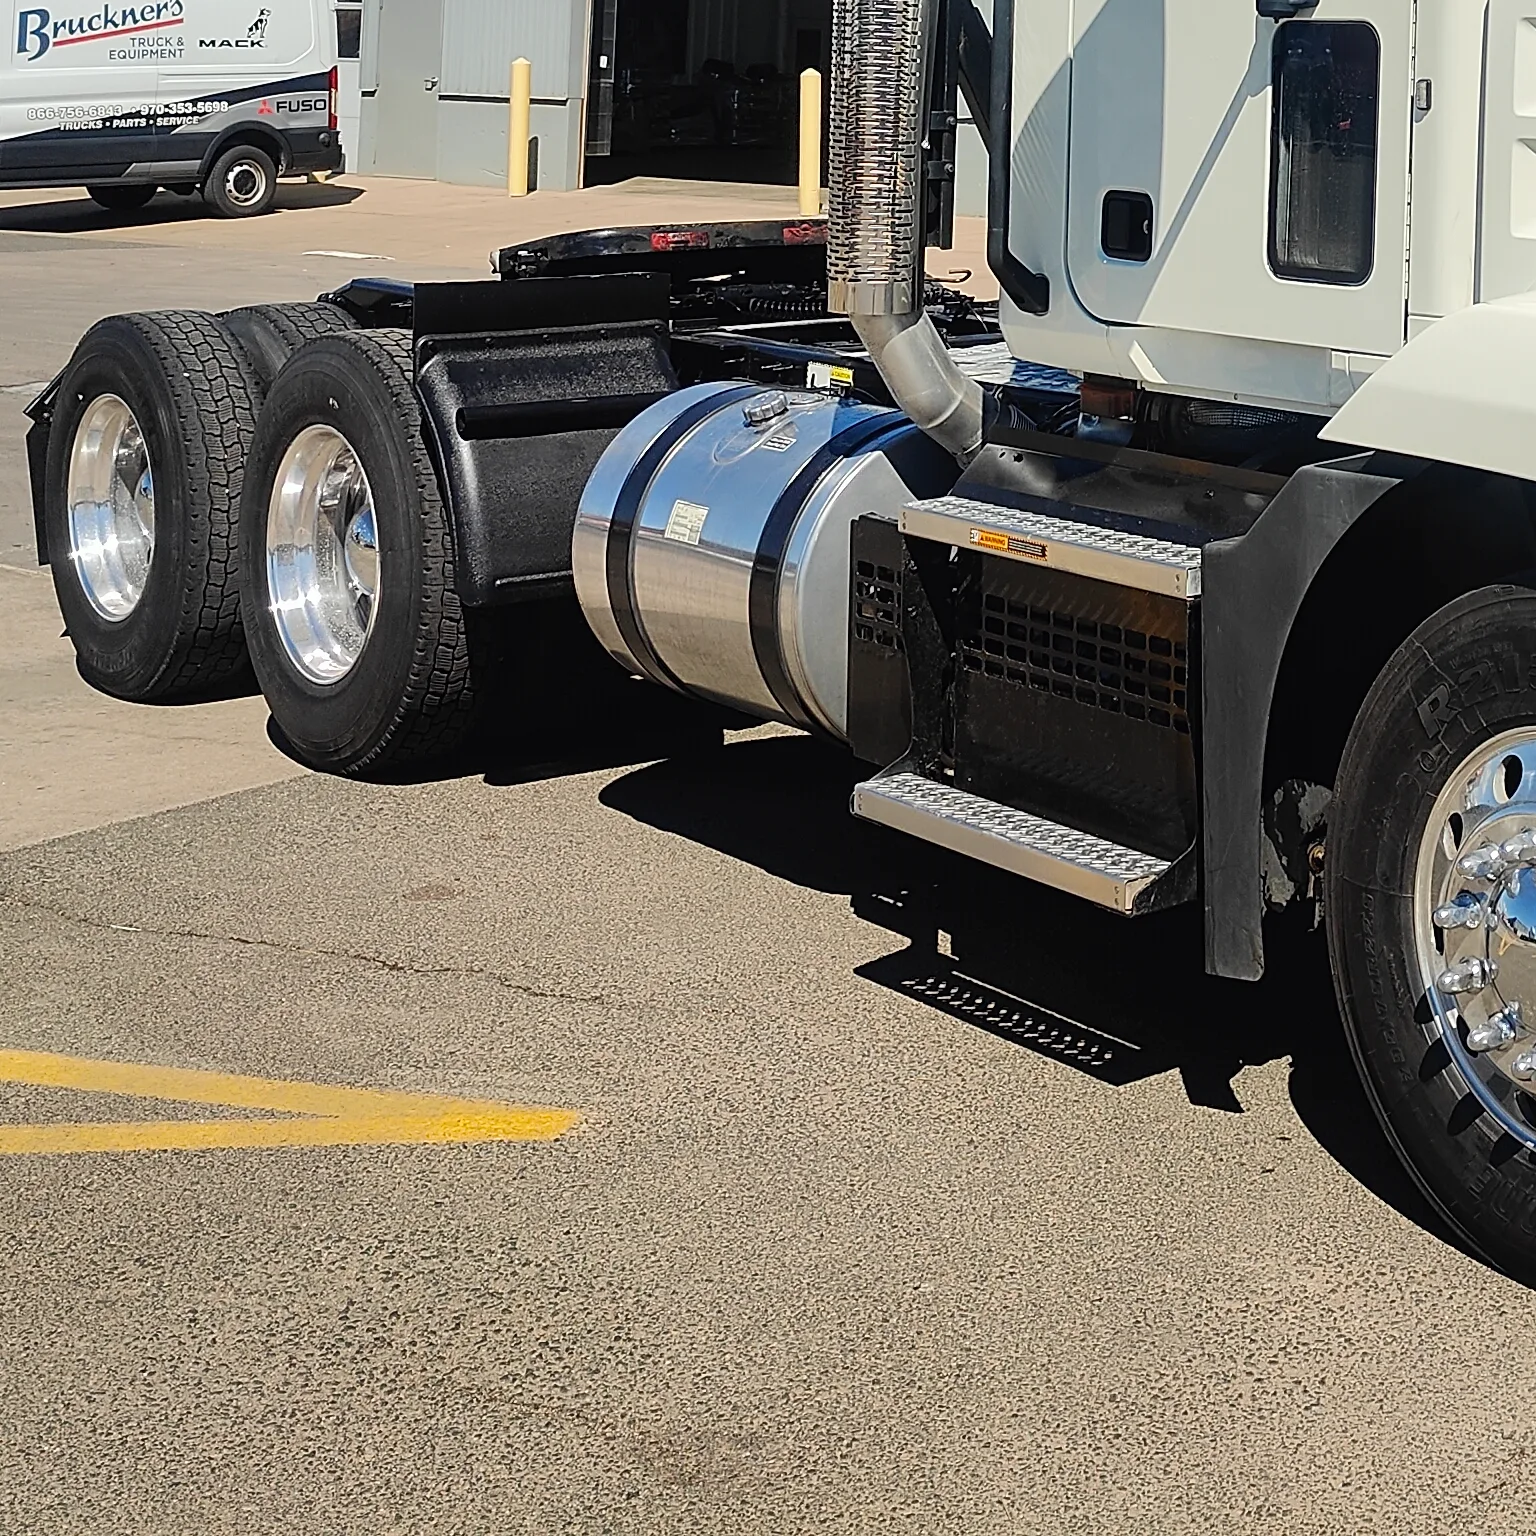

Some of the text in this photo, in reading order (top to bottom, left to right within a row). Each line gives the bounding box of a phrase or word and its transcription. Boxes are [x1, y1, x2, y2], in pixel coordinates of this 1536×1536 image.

[129, 36, 185, 48] TRUCK &
[198, 39, 264, 48] MACK
[109, 48, 185, 60] EQUIPMENT
[276, 99, 327, 113] FUSO
[59, 116, 200, 131] TRUCKS PARTS SERVICE
